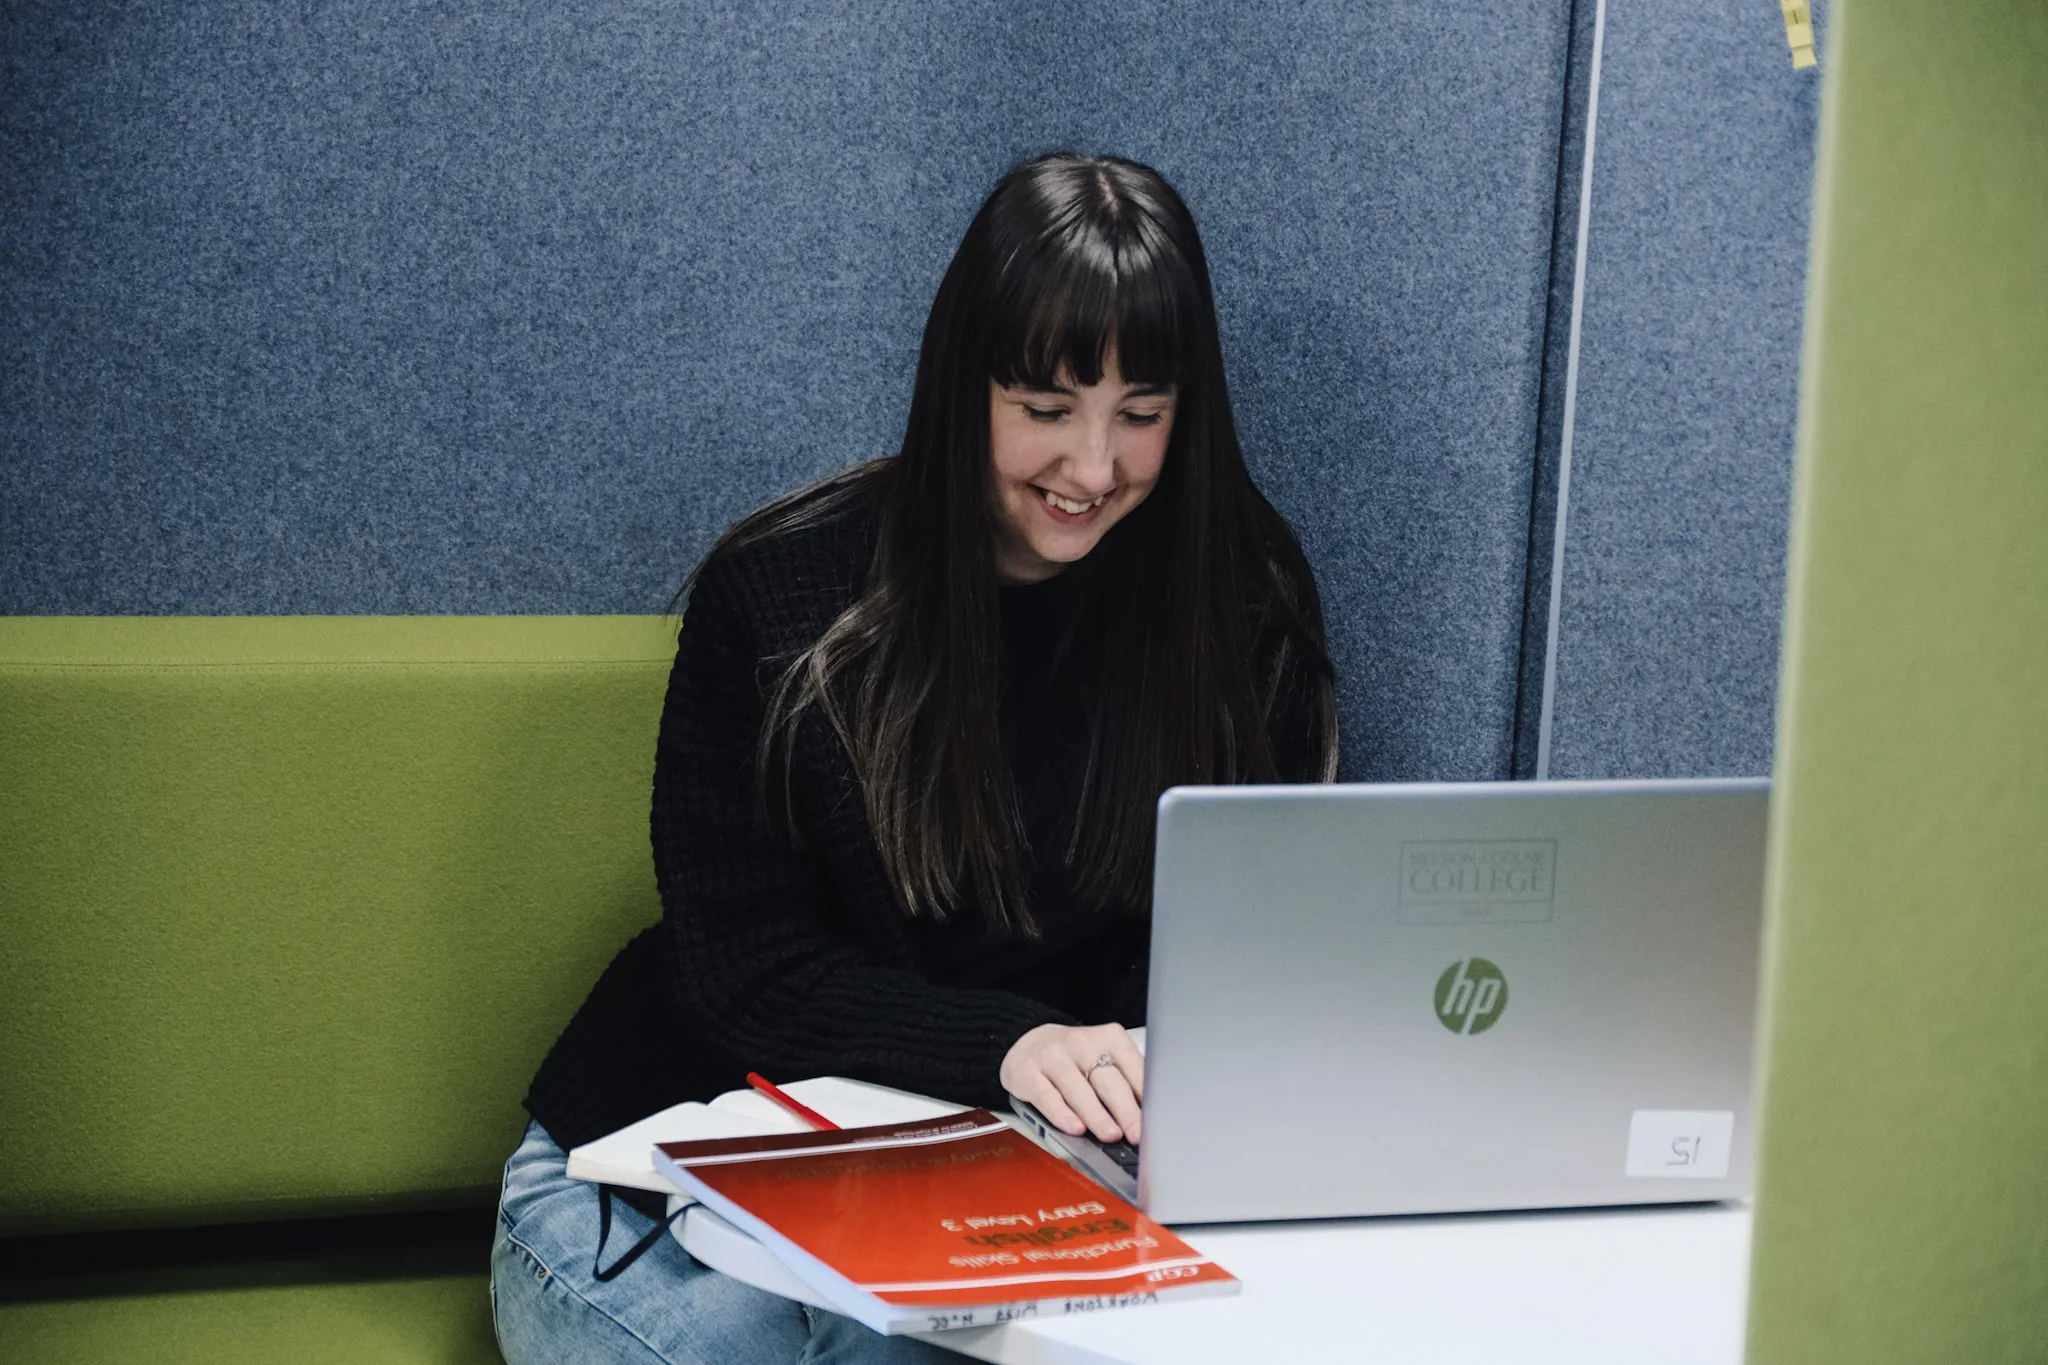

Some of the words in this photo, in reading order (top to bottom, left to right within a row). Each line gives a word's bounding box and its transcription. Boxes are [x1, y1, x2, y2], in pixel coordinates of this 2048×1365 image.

[1409, 866, 1545, 894] COLLEGE
[1440, 957, 1503, 1036] hp
[963, 1214, 1034, 1230] Level
[1037, 1201, 1107, 1223] Entry
[940, 1218, 963, 1232] 3
[963, 1218, 1132, 1248] English
[948, 1251, 1020, 1268] Skills
[1022, 1235, 1159, 1263] Functional
[1147, 1265, 1199, 1282] CGP
